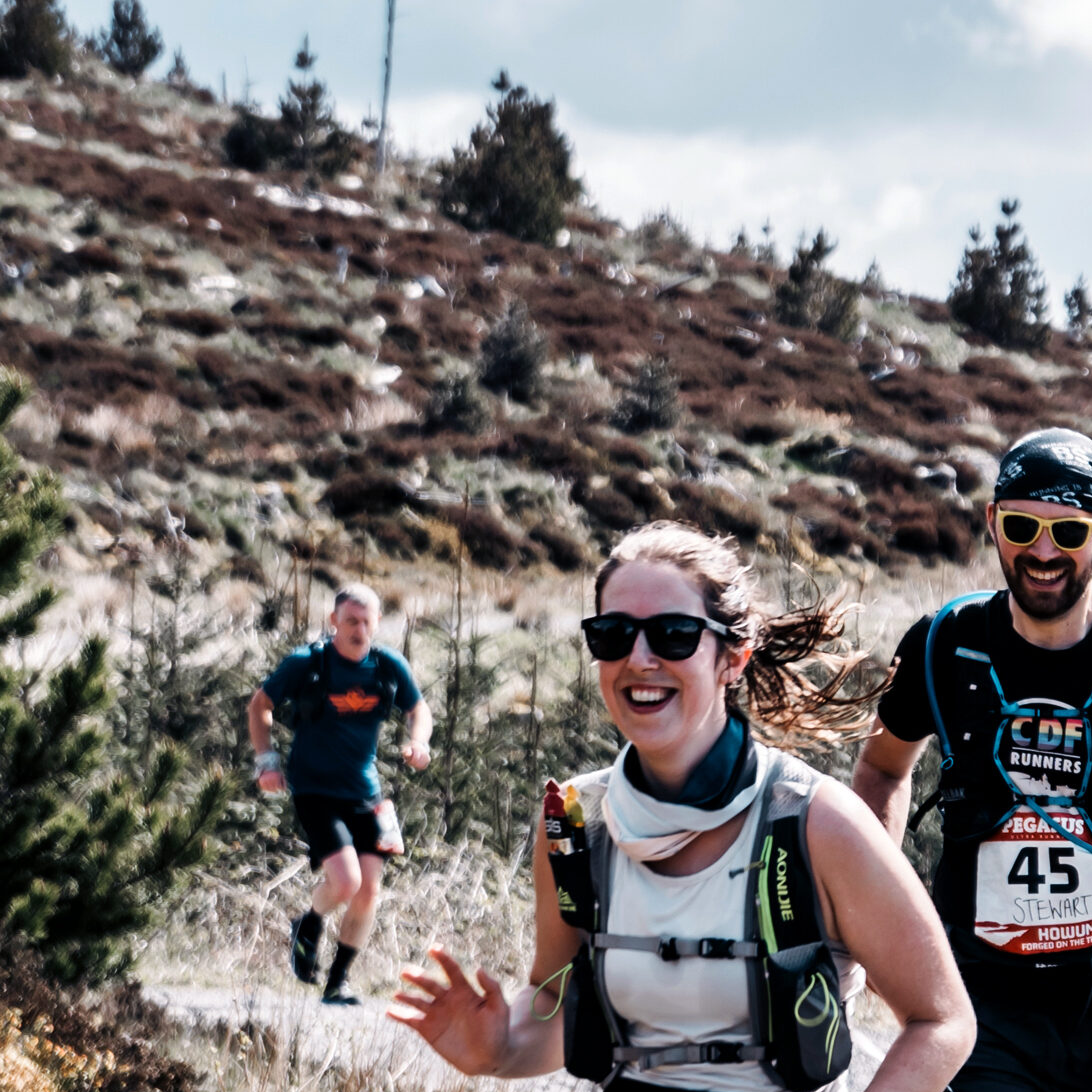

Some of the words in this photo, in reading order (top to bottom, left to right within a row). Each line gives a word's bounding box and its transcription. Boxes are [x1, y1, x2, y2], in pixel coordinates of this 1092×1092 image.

[1011, 717, 1083, 753] CDF
[1010, 751, 1082, 774] RUNNERS
[1002, 817, 1085, 836] PEGAUS
[776, 847, 794, 922] AONIJIE
[1007, 846, 1080, 894] 45
[1012, 894, 1092, 923] STEWART
[1021, 940, 1054, 951] FORGED
[1055, 938, 1069, 949] ON
[1069, 935, 1085, 946] THE
